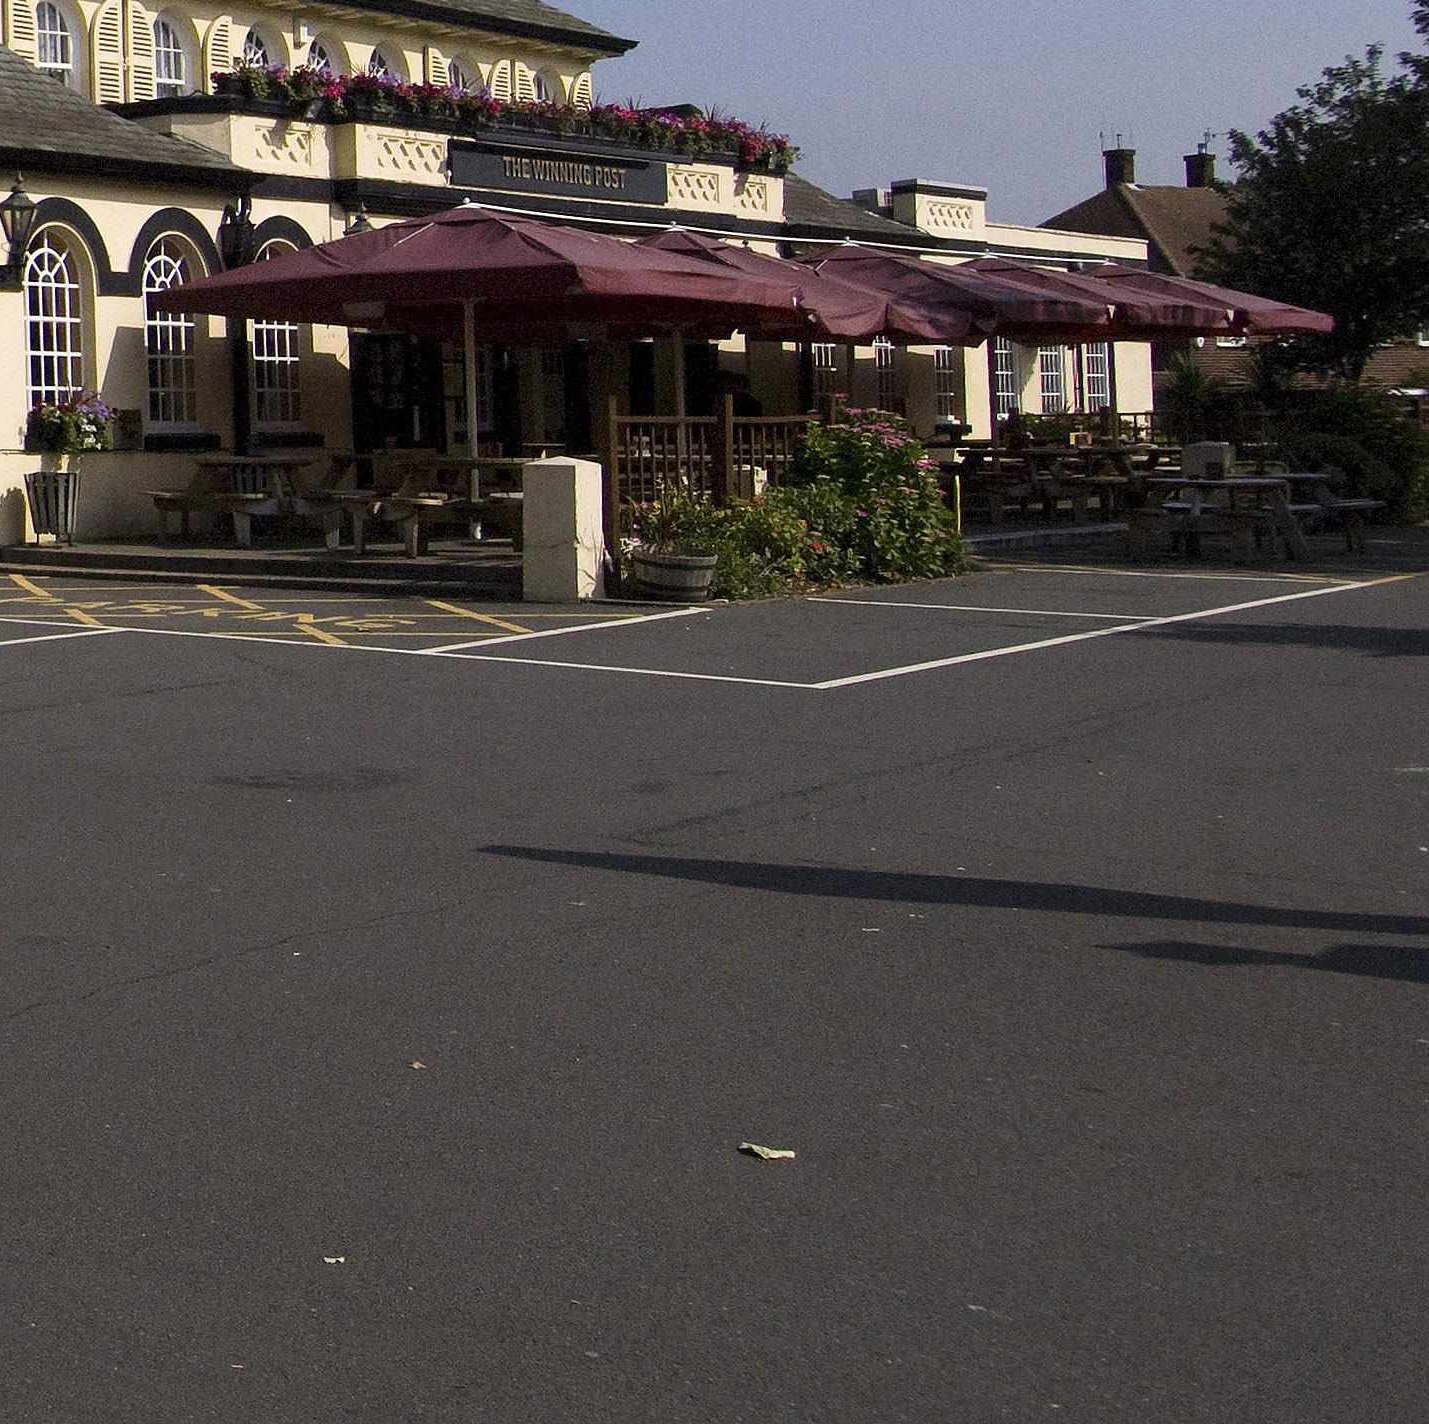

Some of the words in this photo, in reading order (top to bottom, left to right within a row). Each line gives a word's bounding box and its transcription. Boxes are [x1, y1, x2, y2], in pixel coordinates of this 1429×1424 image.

[502, 156, 531, 178] THE
[532, 160, 591, 185] WINNING
[594, 166, 627, 189] POST
